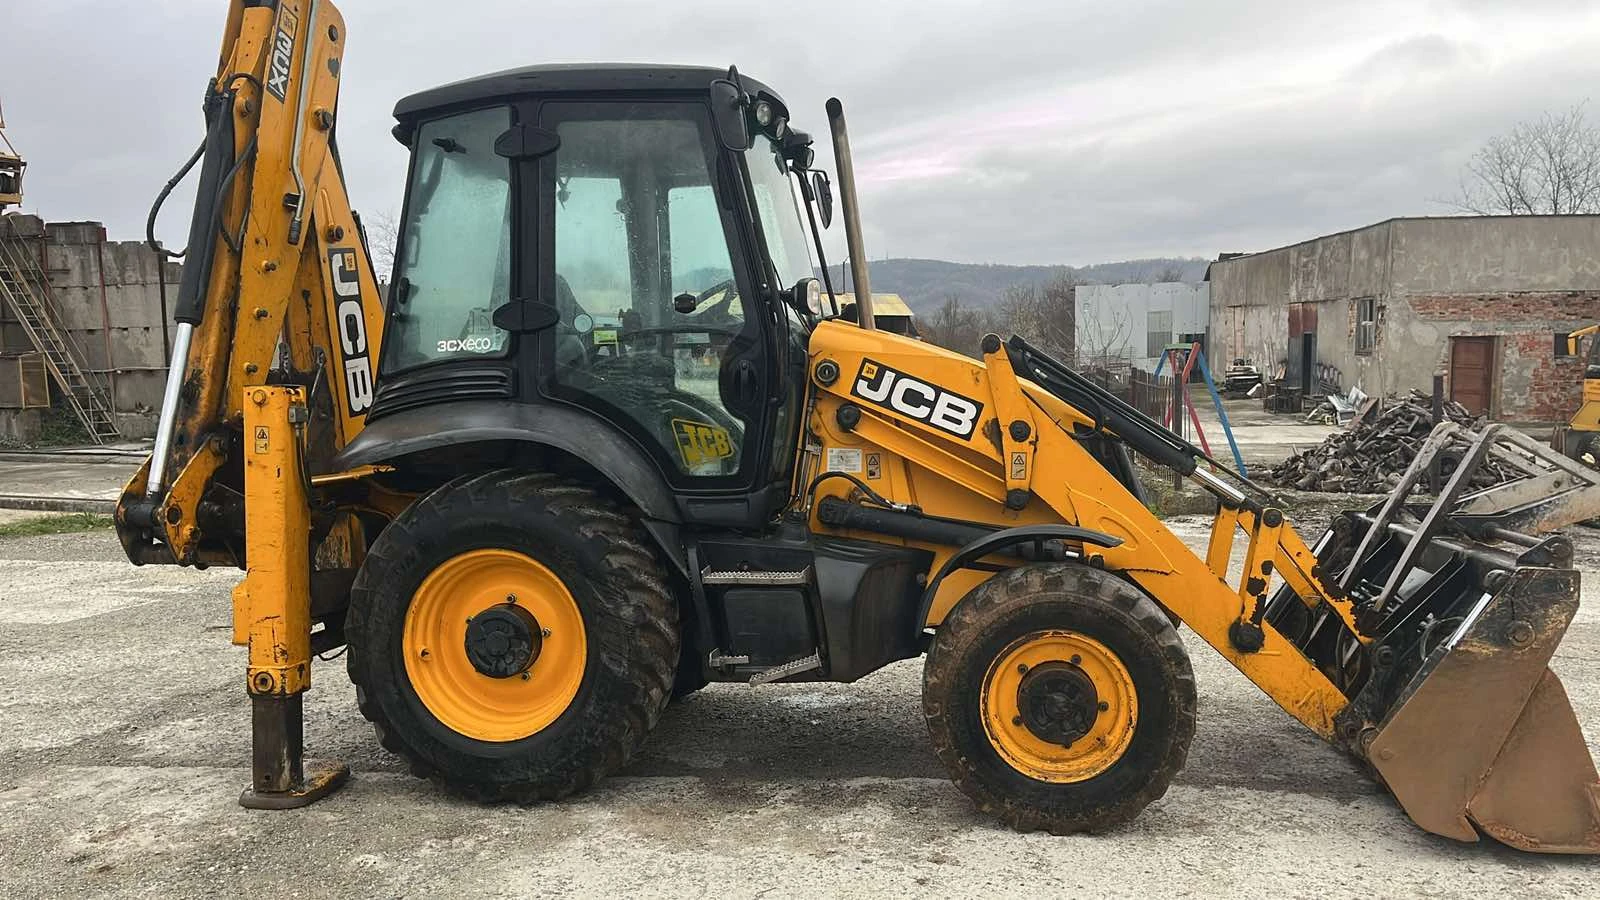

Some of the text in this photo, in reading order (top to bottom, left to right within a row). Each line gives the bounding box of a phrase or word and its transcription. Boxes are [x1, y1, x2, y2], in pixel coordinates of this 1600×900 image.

[268, 31, 292, 96] 3CX
[331, 252, 373, 413] JCB
[437, 337, 491, 352] 3CXeco
[856, 370, 977, 435] JCB
[681, 423, 730, 466] JCB
